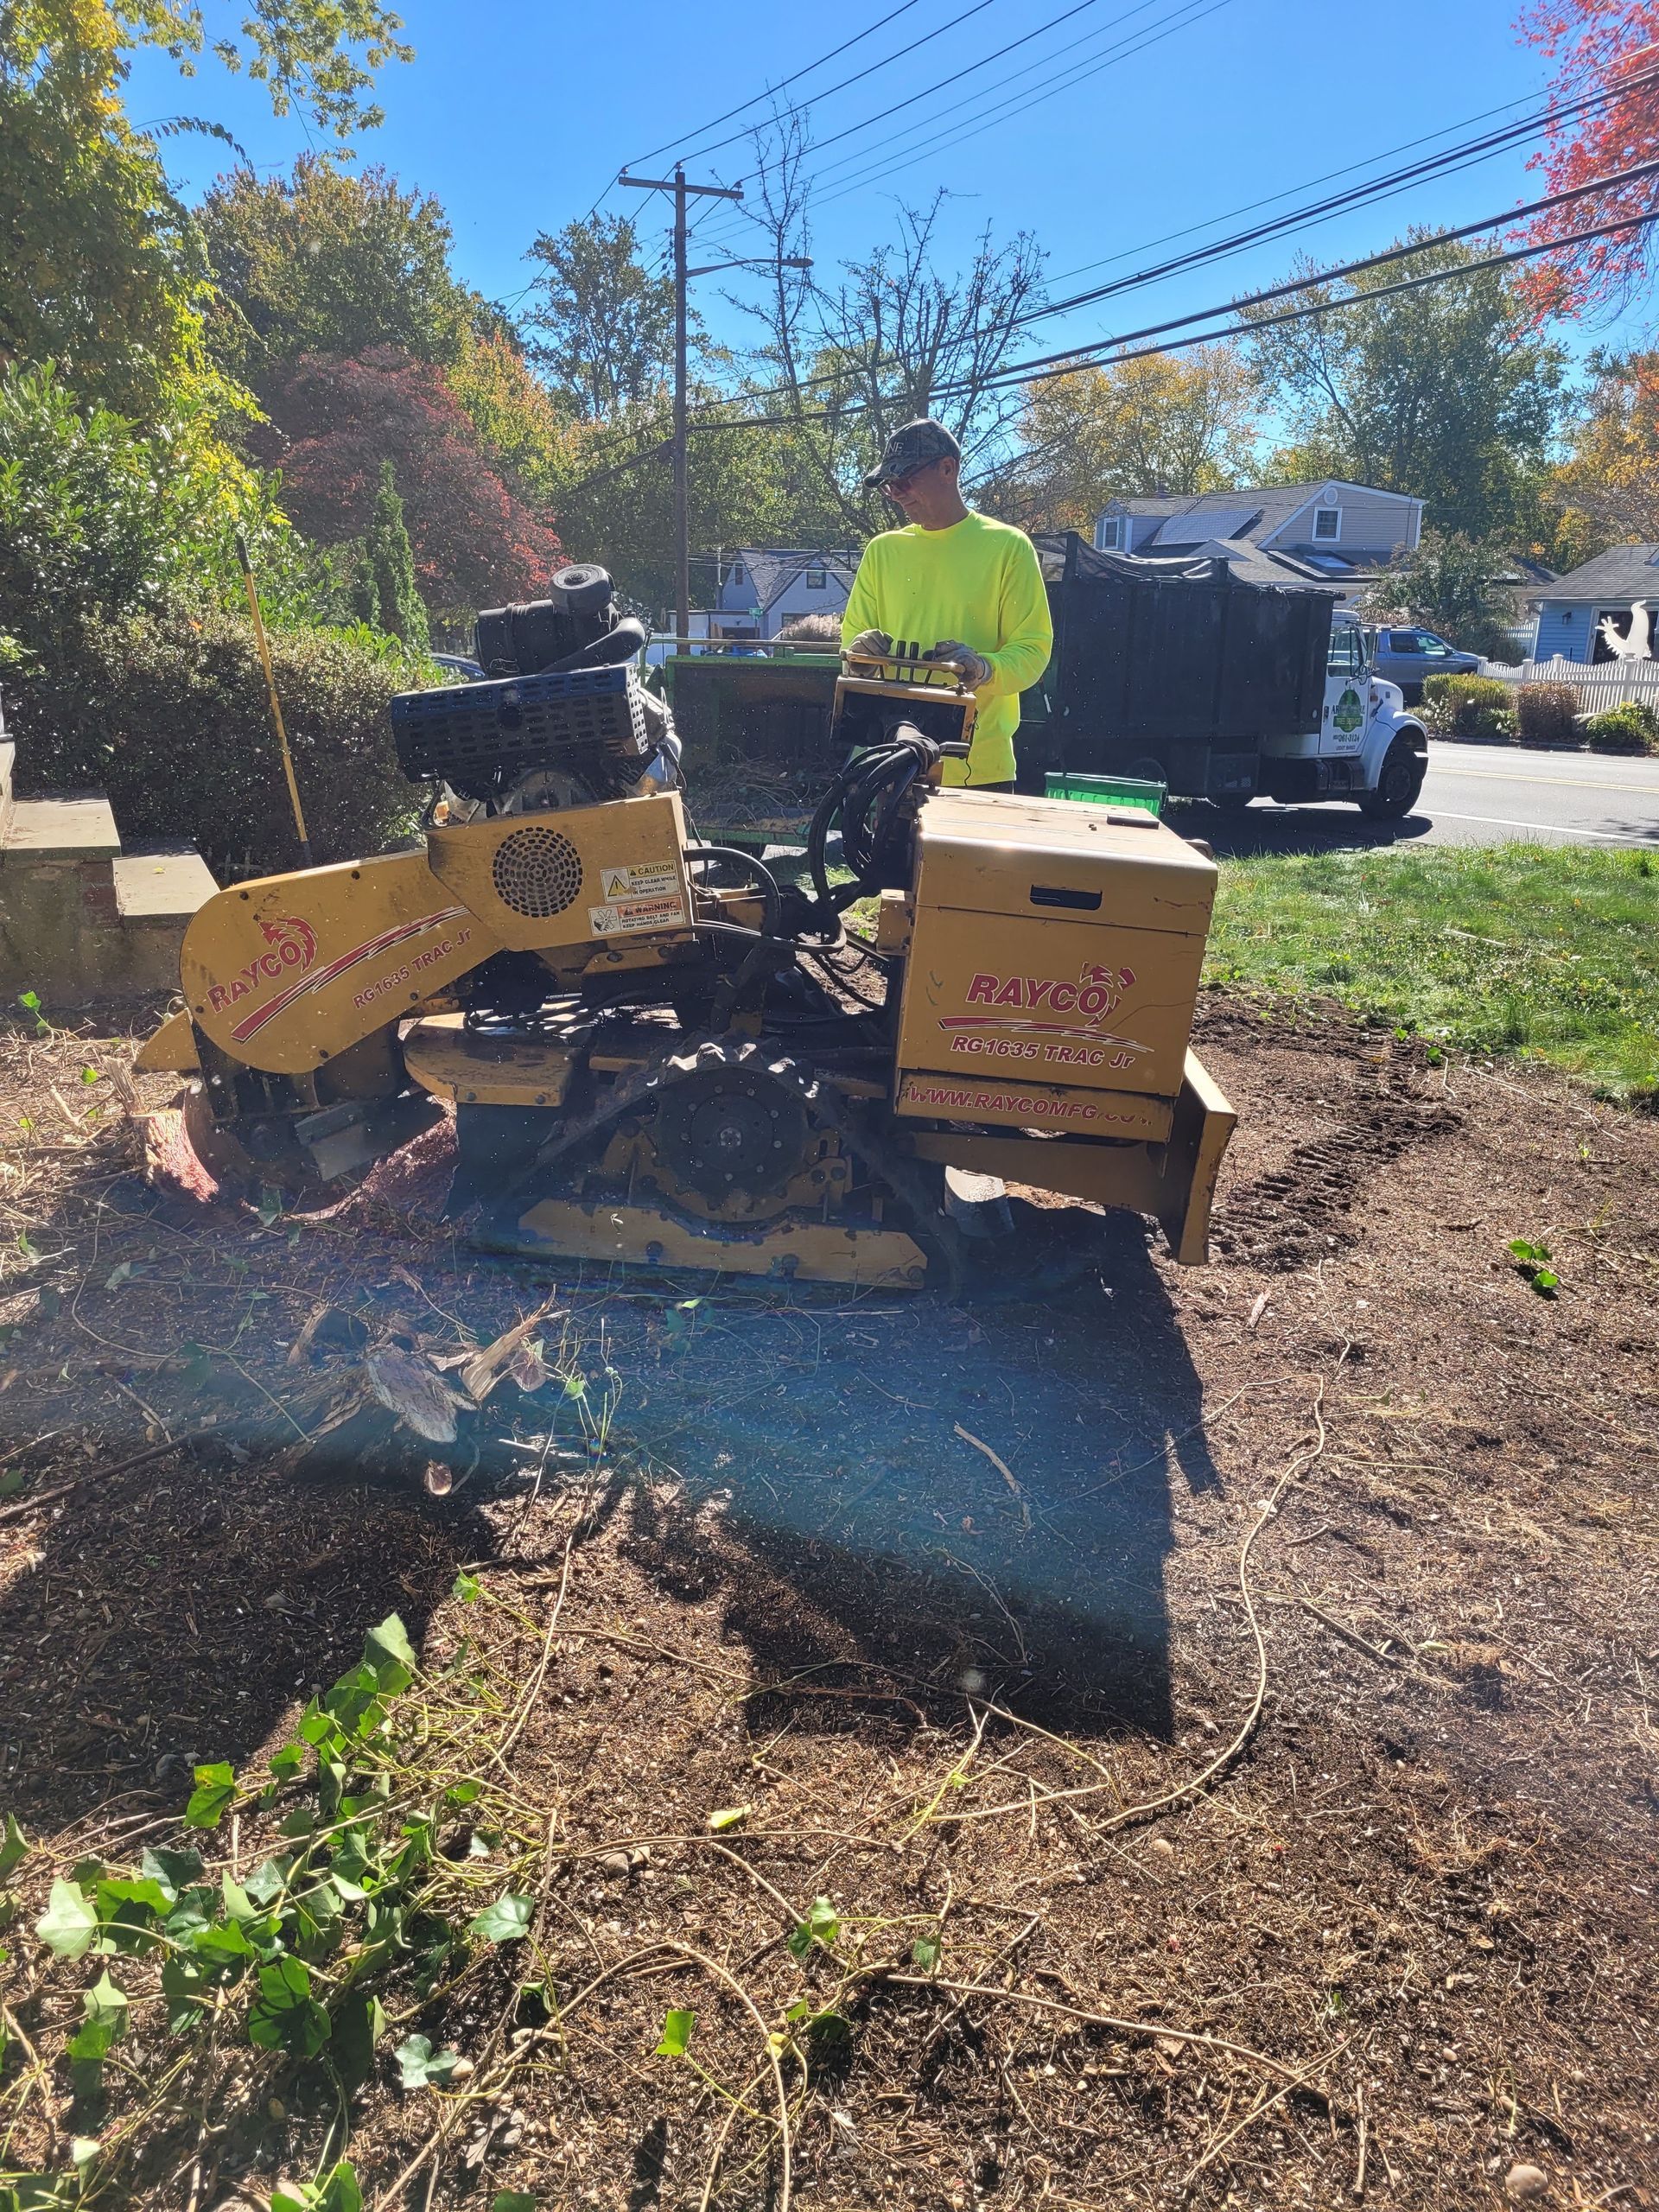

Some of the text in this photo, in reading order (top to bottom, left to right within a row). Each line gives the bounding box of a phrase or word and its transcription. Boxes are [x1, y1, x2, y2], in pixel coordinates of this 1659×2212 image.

[638, 864, 674, 875] CAUTION
[635, 901, 677, 913] WARNING
[639, 886, 666, 894] OPERATION
[207, 939, 302, 1014] RAYCO
[353, 927, 472, 1010] RG1635 TRAC Jr
[964, 973, 1109, 1015] RAYCO
[950, 1035, 1137, 1070] RG1635 TRAC Jr
[910, 1086, 1153, 1127] WWW.RAYCOMFG.
